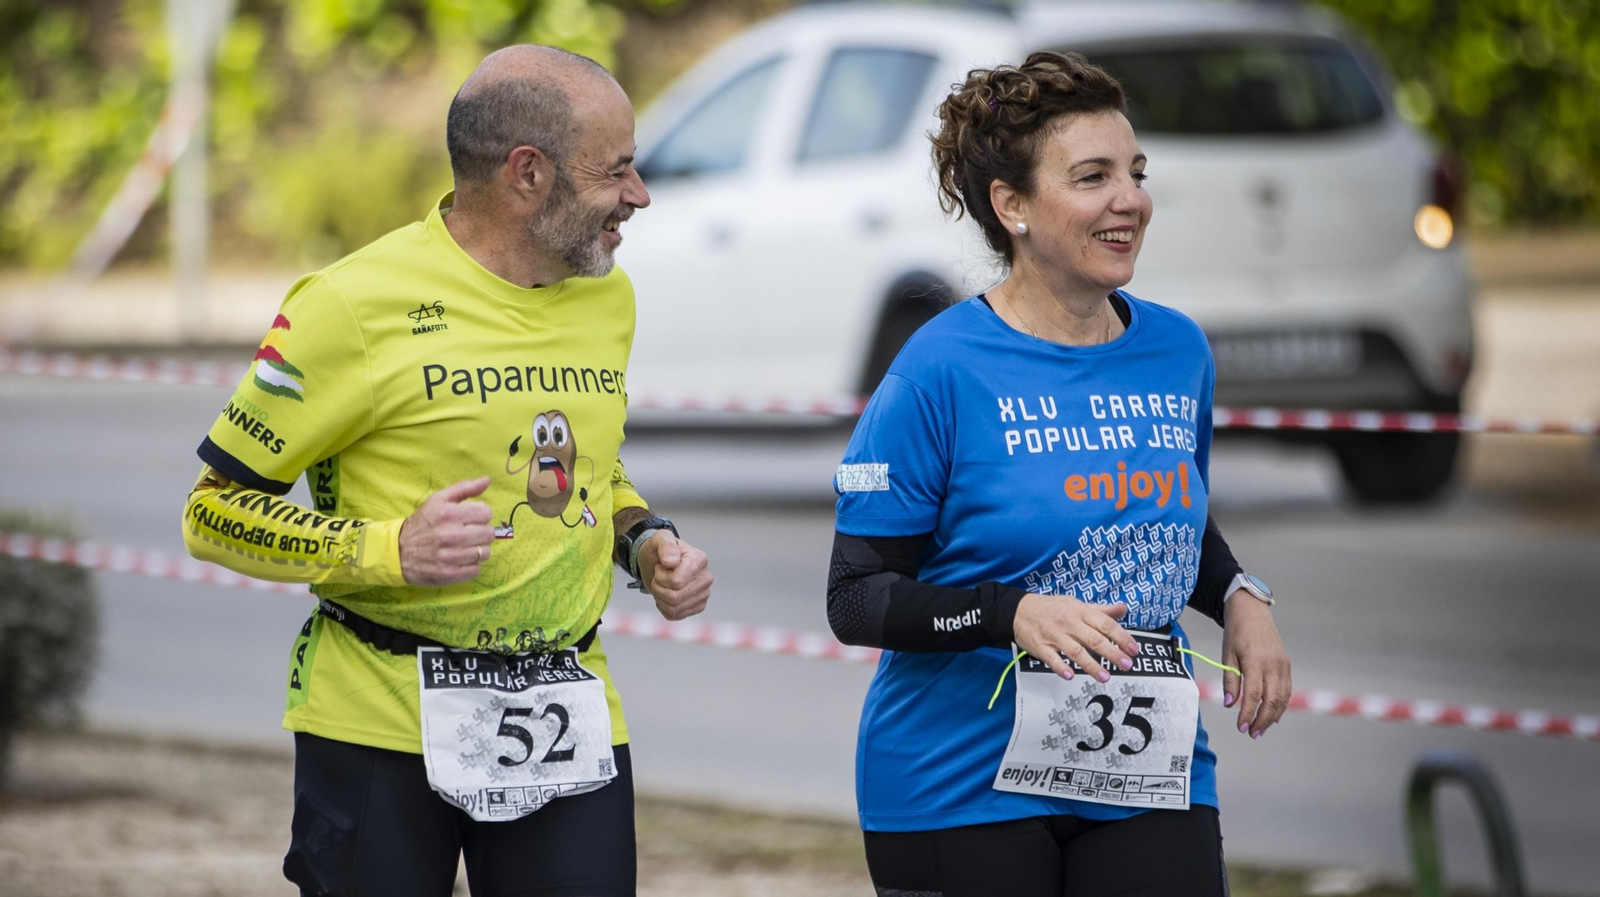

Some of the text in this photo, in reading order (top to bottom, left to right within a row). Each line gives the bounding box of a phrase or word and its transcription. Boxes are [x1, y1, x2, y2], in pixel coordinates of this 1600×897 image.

[411, 323, 449, 336] GAÑAFOTE
[998, 394, 1198, 424] XLV CARRERA
[1005, 424, 1137, 456] POPULAR
[1063, 460, 1192, 511] enjoy!
[278, 536, 320, 555] CLUB
[1132, 657, 1185, 675] JEREZ
[433, 669, 589, 691] POPULAR JEREZ
[496, 702, 577, 767] 52
[1075, 694, 1156, 756] 35
[1001, 766, 1052, 789] enjoy!
